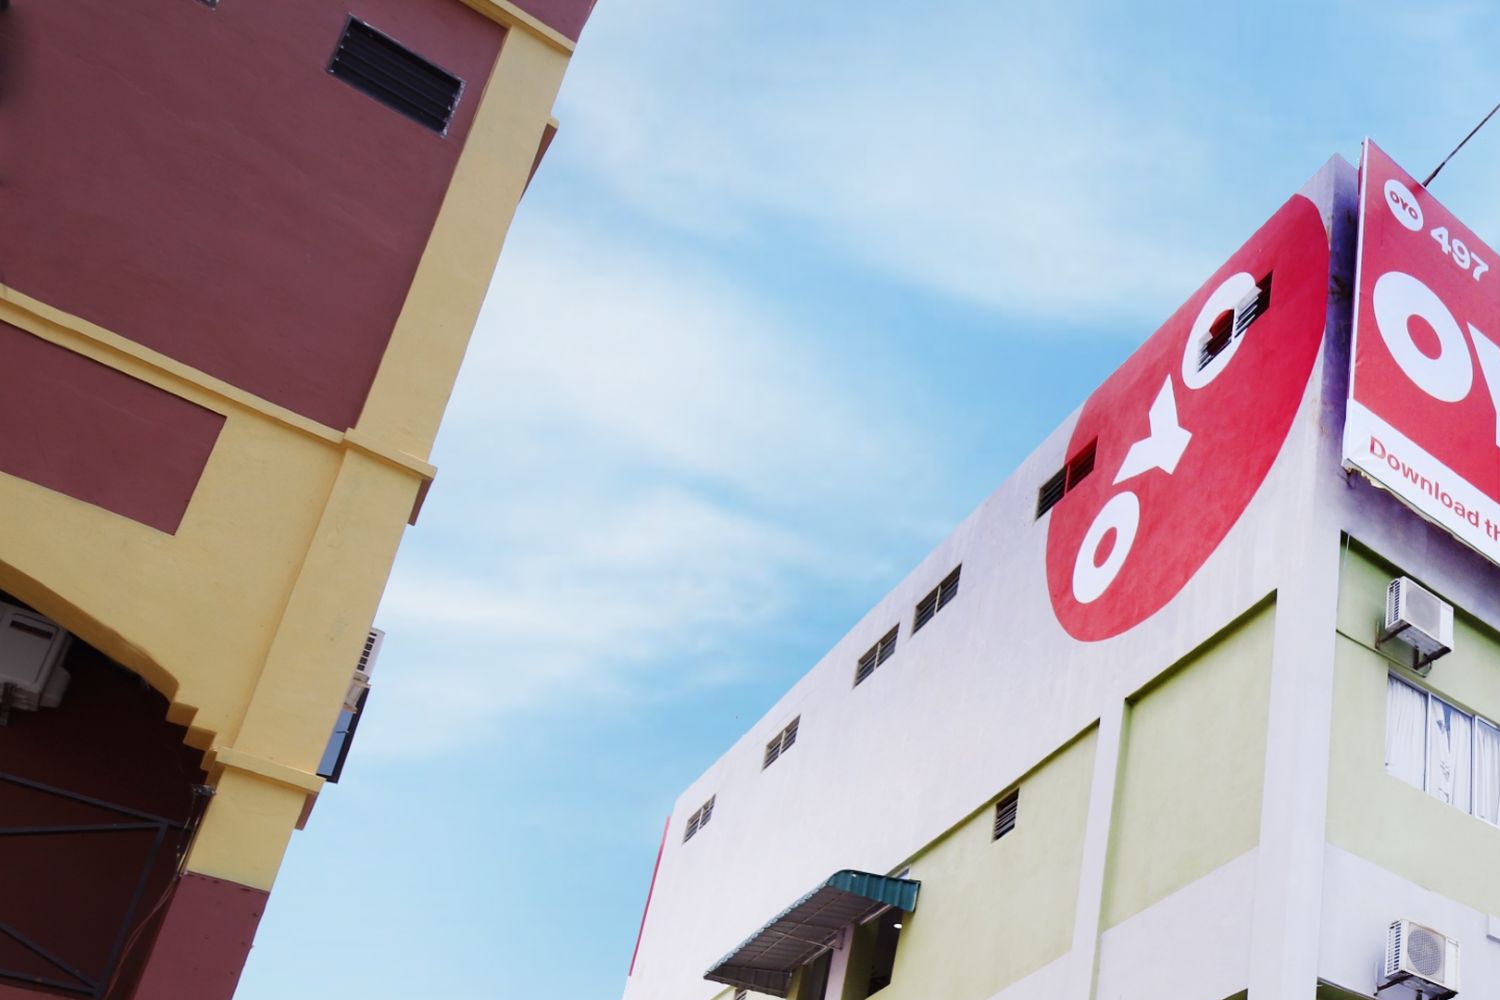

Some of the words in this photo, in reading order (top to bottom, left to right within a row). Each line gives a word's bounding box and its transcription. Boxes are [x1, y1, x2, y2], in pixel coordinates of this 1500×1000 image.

[1390, 191, 1418, 220] OYO
[1430, 226, 1489, 281] 497
[1072, 271, 1258, 605] OYO
[1369, 436, 1479, 528] Download
